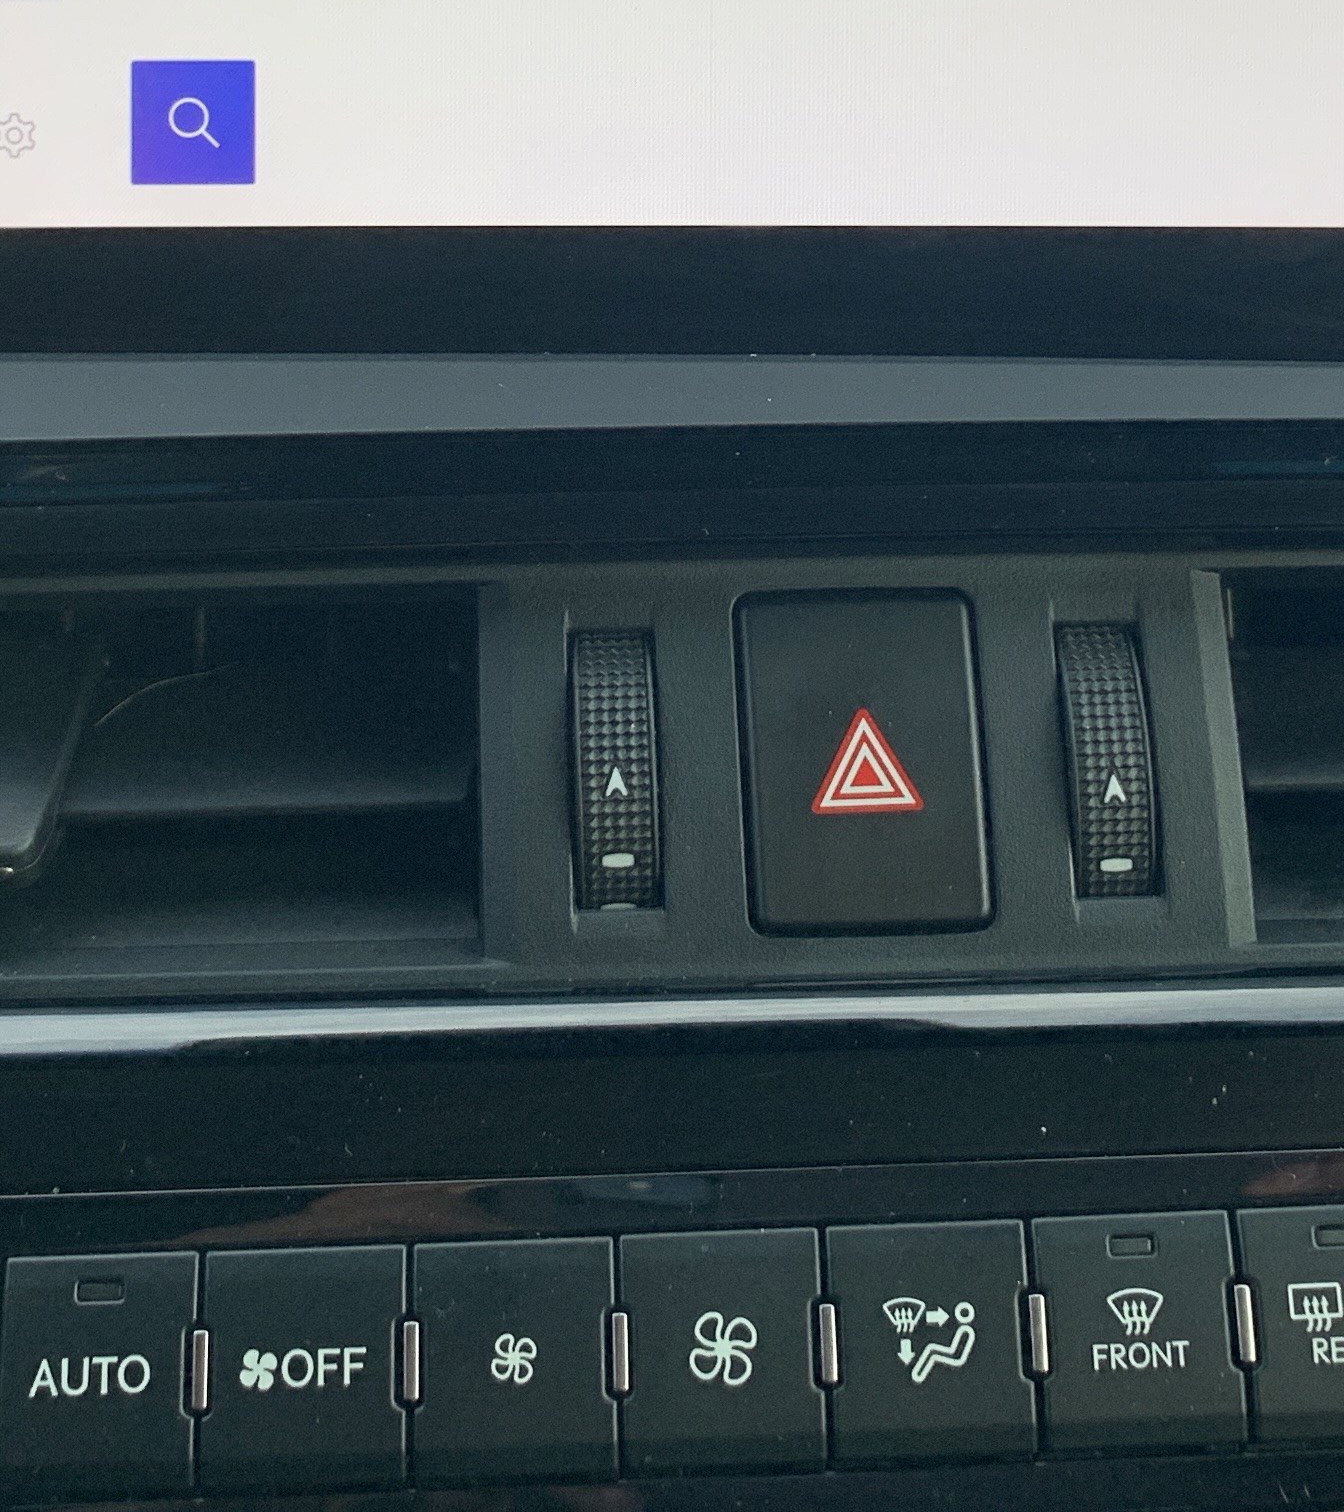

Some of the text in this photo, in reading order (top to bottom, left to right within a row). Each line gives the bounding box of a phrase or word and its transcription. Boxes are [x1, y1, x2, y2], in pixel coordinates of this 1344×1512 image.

[28, 1354, 151, 1399] AUTO
[280, 1346, 367, 1389] OFF
[1092, 1340, 1190, 1372] FRONT
